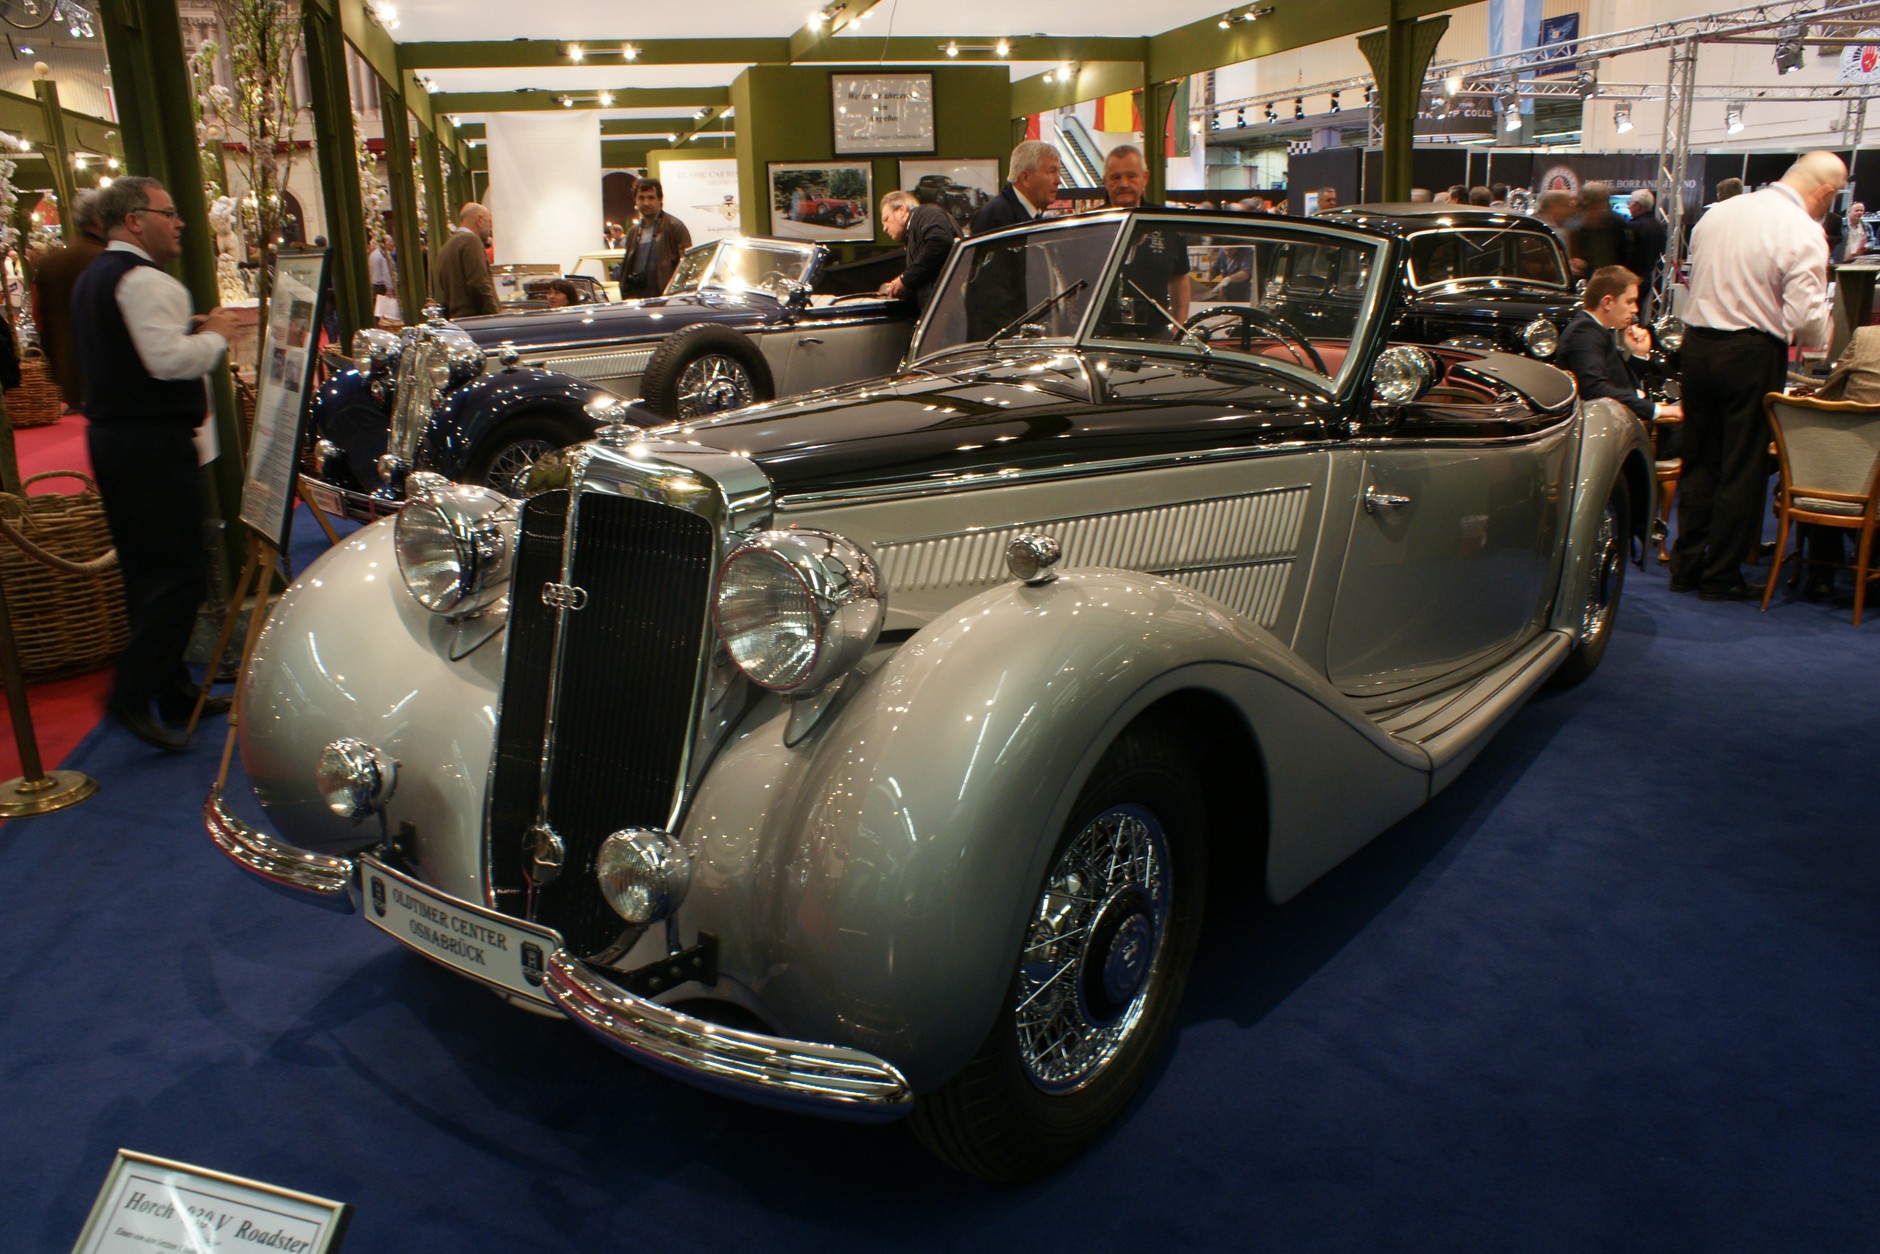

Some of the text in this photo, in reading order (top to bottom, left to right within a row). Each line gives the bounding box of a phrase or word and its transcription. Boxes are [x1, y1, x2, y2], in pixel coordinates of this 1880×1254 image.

[392, 887, 449, 929] OLDTIMER
[450, 917, 508, 951] CENTER
[409, 918, 486, 966] OSNABRÜCK
[124, 1191, 175, 1219] Horch
[234, 1219, 310, 1254] Roadster
